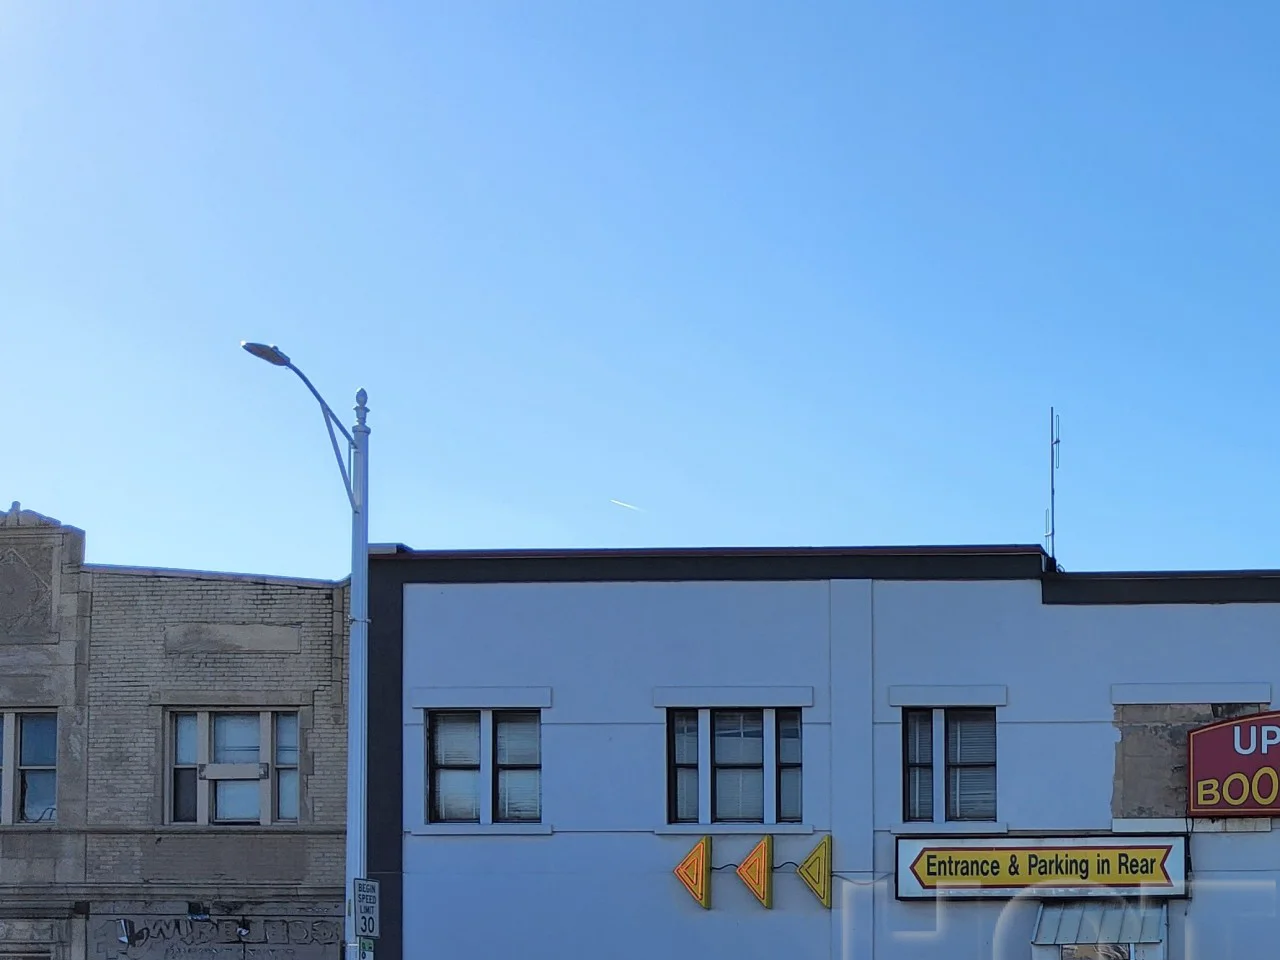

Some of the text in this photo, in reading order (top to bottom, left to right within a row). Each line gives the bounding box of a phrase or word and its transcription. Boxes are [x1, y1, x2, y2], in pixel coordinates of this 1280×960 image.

[926, 853, 1157, 880] Entrance & Parking in Rear
[358, 883, 376, 893] BEGIN
[358, 894, 377, 904] SPEED
[359, 905, 375, 915] LIMIT
[360, 916, 375, 933] 30
